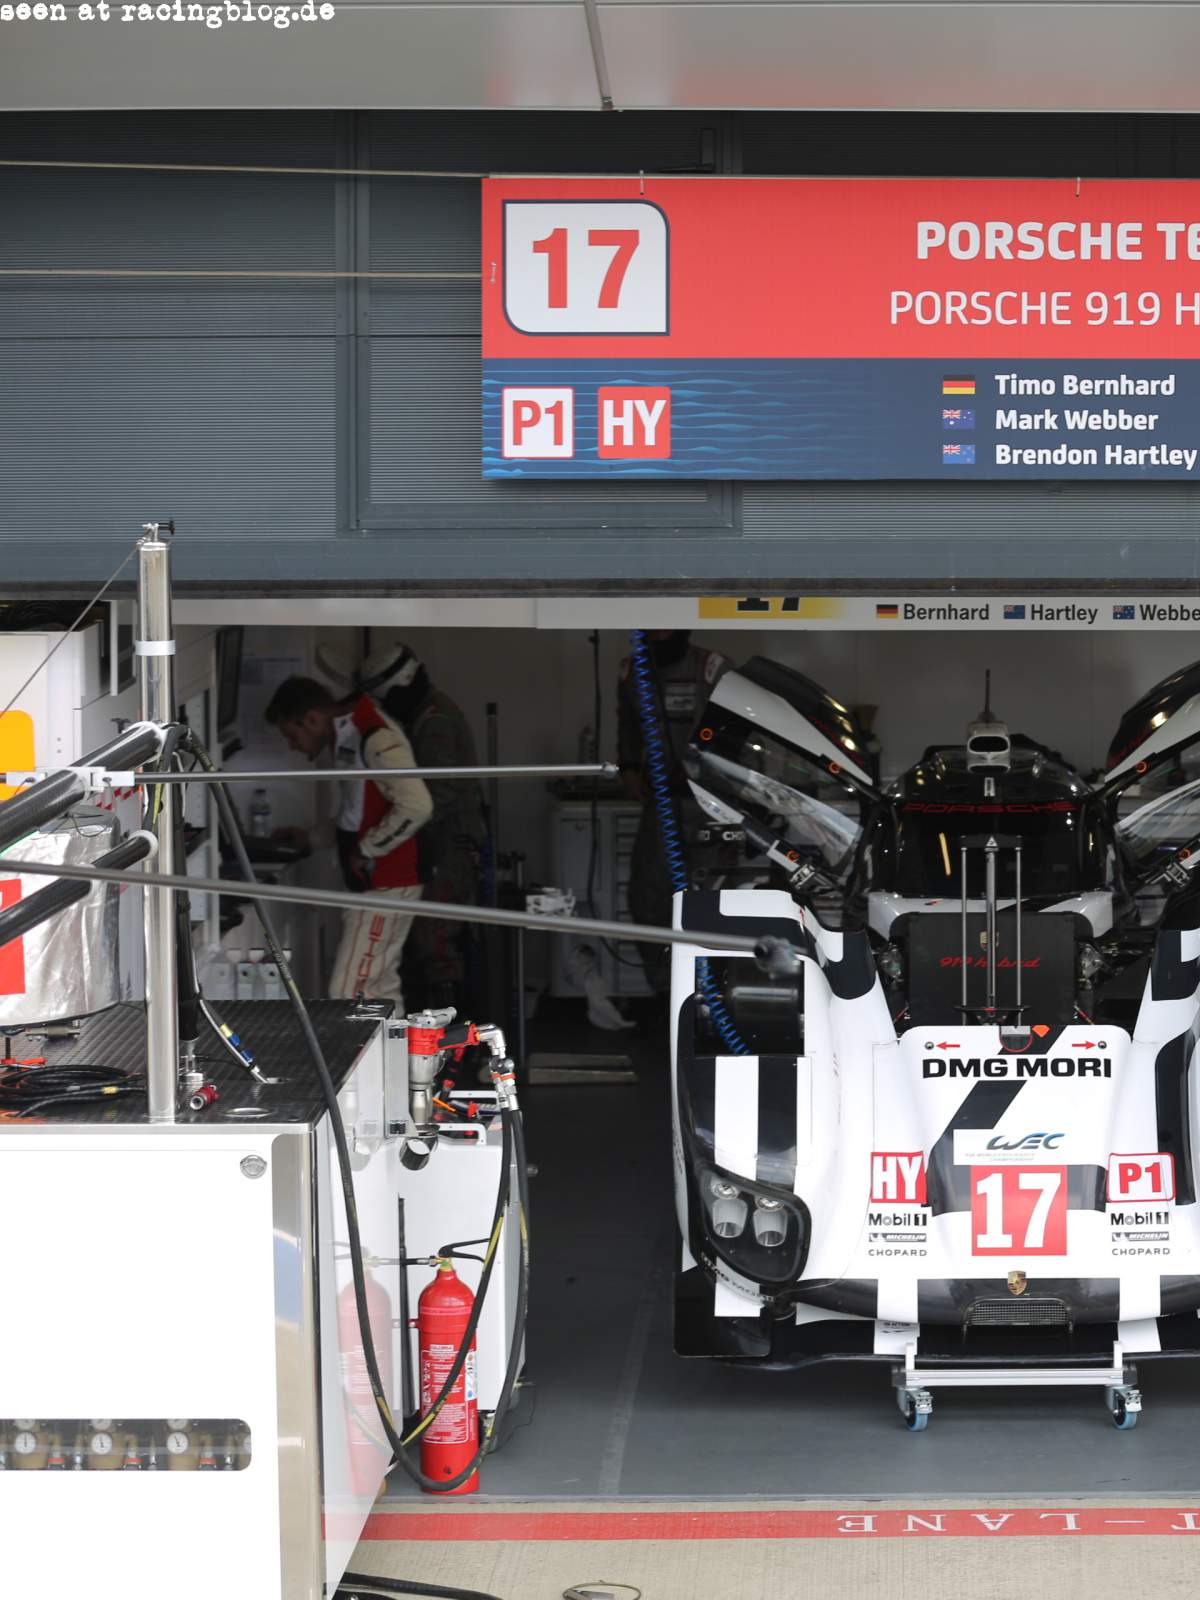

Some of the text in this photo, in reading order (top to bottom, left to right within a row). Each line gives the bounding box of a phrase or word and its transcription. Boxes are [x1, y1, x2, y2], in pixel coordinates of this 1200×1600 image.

[917, 221, 1143, 260] PORSCHE
[533, 228, 641, 309] 17
[889, 291, 1072, 326] PORSCHE
[1085, 292, 1161, 326] 919
[995, 374, 1176, 397] Timo Bernhard
[512, 400, 564, 446] P1
[603, 400, 667, 446] HY
[995, 409, 1159, 431] Mark Webber
[995, 444, 1198, 471] Brendon Hartley
[903, 602, 990, 622] Bernhard
[1030, 603, 1099, 625] Hartley
[902, 801, 1077, 813] PORSCHE
[922, 1058, 1112, 1079] DMG MORI
[986, 1132, 1065, 1151] WEC
[872, 1154, 924, 1200] HY
[1118, 1161, 1162, 1194] P1
[868, 1212, 911, 1227] Mobil
[976, 1172, 1062, 1249] 17
[1110, 1211, 1153, 1226] Mobil
[868, 1248, 928, 1257] CHOPARD
[1111, 1247, 1171, 1256] CHOPARD
